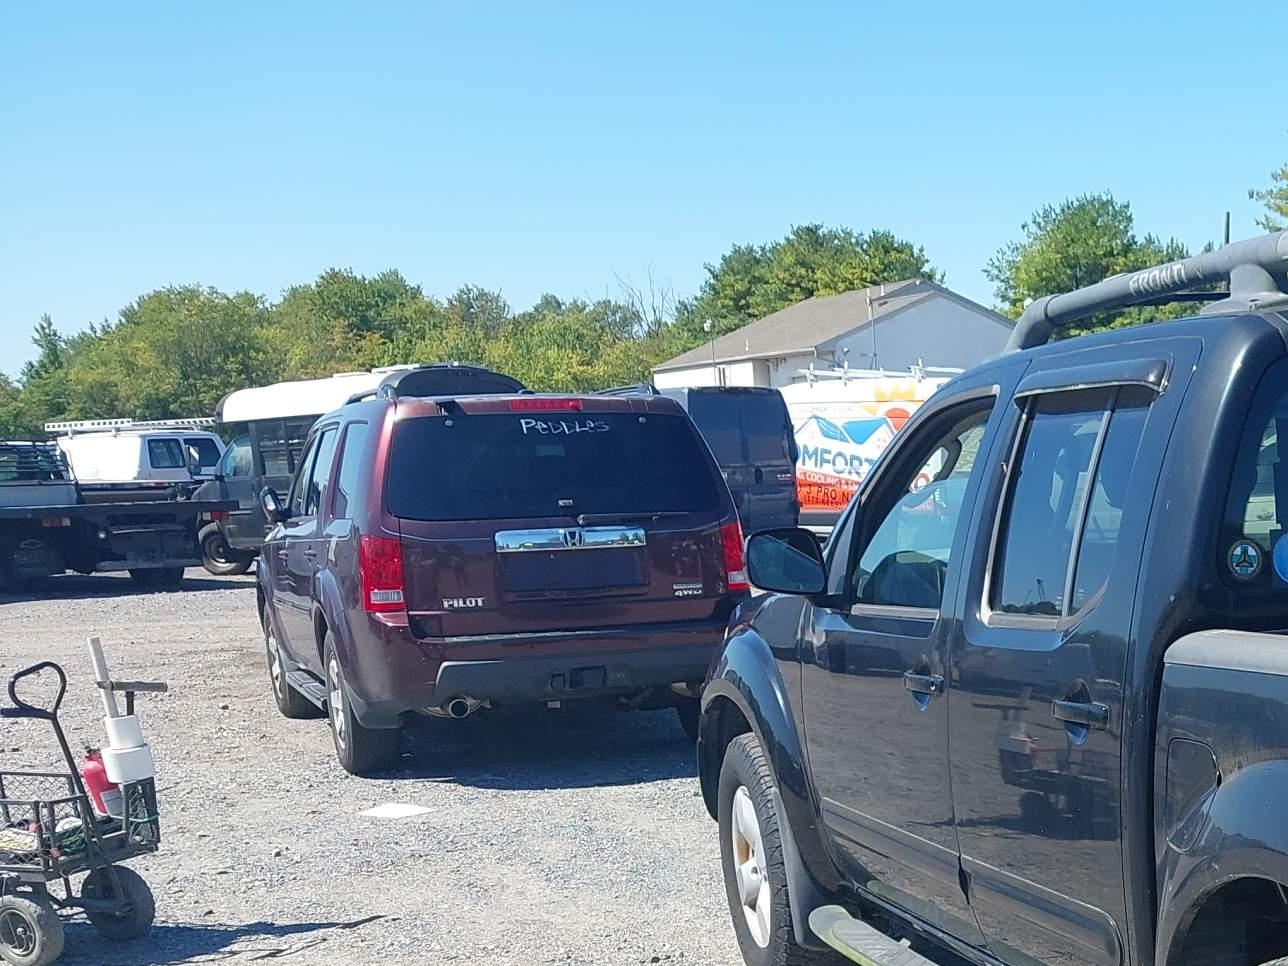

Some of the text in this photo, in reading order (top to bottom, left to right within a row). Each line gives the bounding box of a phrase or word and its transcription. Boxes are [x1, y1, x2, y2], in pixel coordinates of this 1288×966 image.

[817, 486, 837, 501] PRO
[674, 589, 702, 597] 4WD
[442, 597, 485, 608] PILOT
